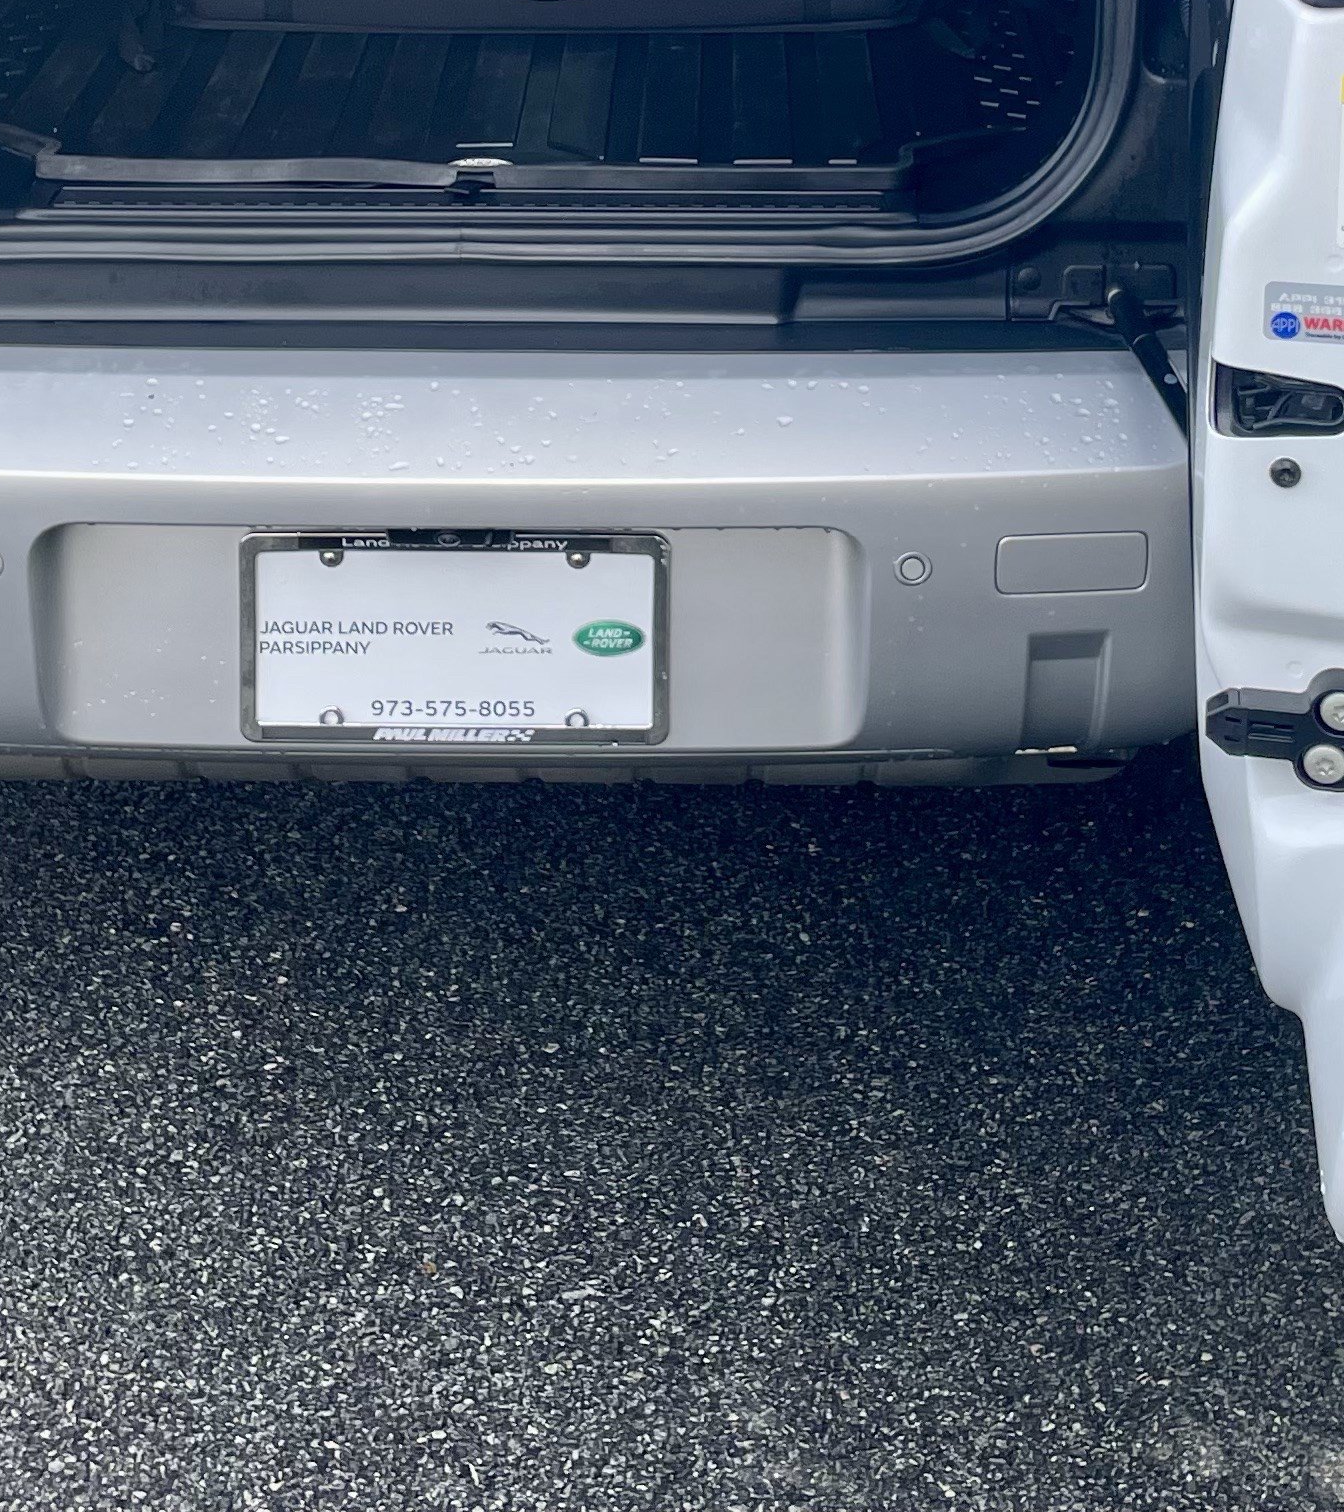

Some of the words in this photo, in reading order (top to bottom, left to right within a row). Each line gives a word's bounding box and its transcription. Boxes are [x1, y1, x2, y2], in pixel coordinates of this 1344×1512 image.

[259, 620, 333, 635] JAGUAR
[338, 621, 388, 635] LAND
[393, 621, 454, 636] ROVER
[259, 640, 371, 655] PARSIPPANY
[478, 646, 553, 655] JAGUAR
[371, 699, 535, 717] 973-575-8055
[372, 727, 427, 742] PAUL
[427, 727, 510, 742] MILLER
